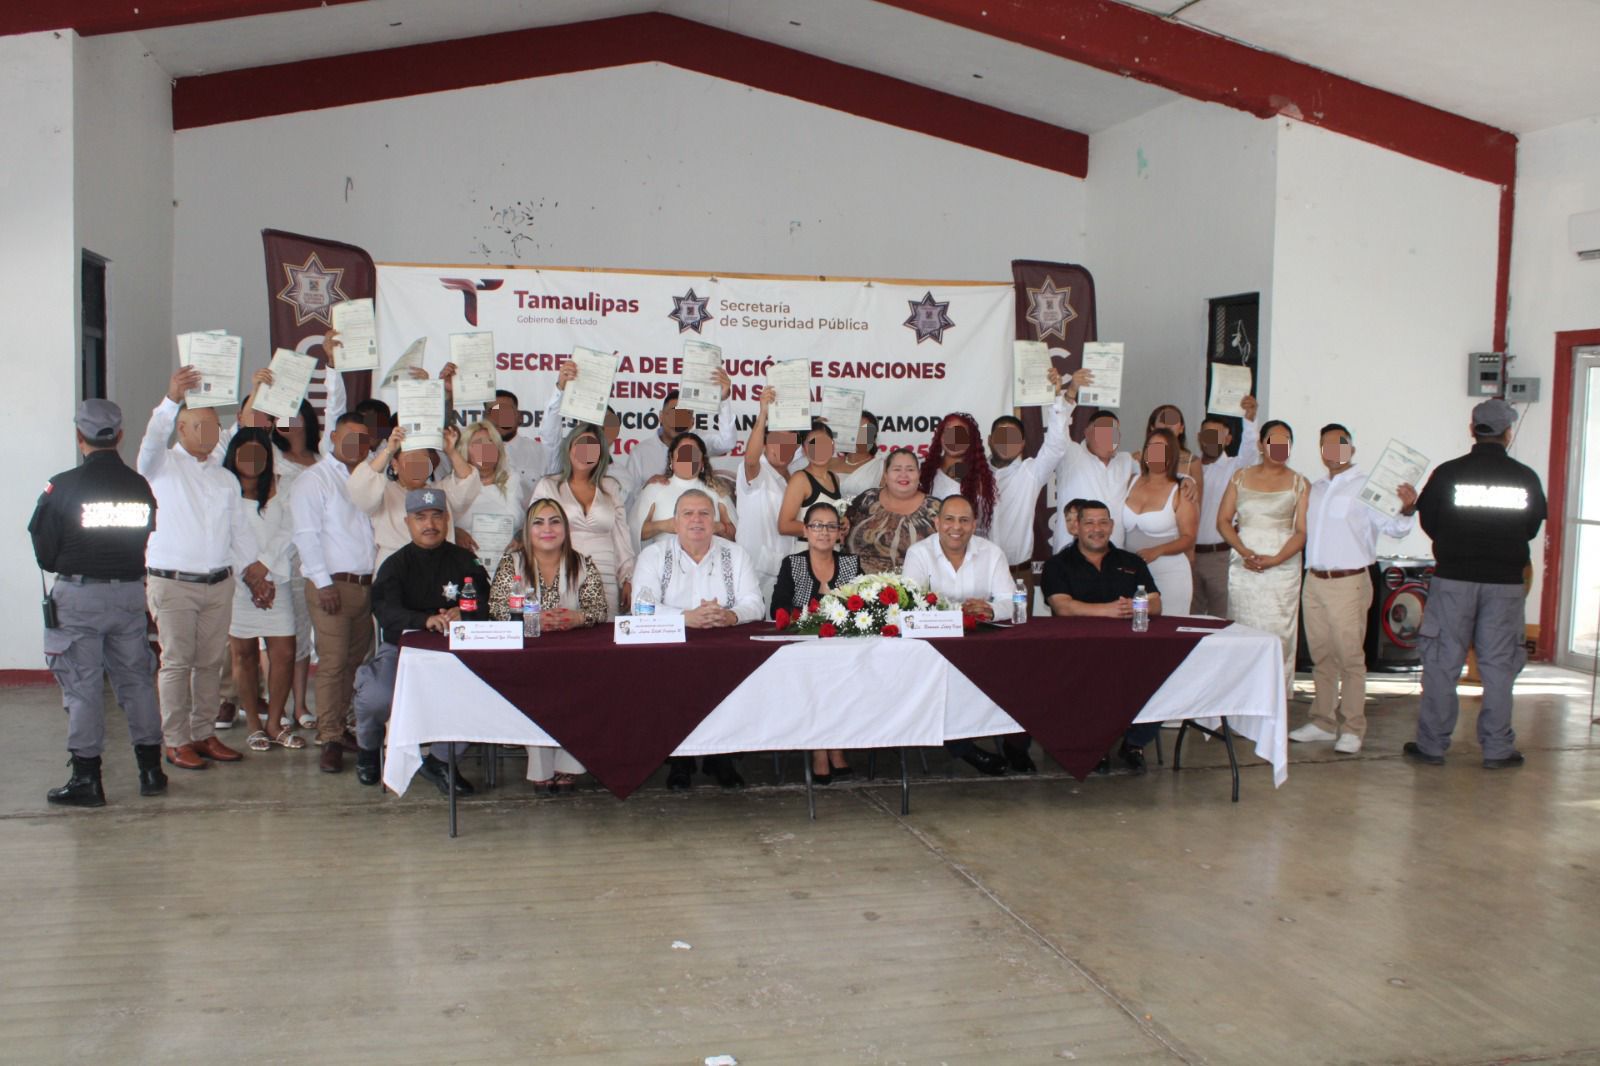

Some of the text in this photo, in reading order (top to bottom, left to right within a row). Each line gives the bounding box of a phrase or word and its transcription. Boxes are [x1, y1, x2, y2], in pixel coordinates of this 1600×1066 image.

[513, 289, 639, 316] Tamaulipas
[719, 299, 790, 313] Secretaría
[517, 315, 597, 325] Gobierno del Estado
[719, 315, 869, 331] de Seguridad Pública
[640, 357, 667, 374] DE
[828, 362, 946, 379] SANCIONES
